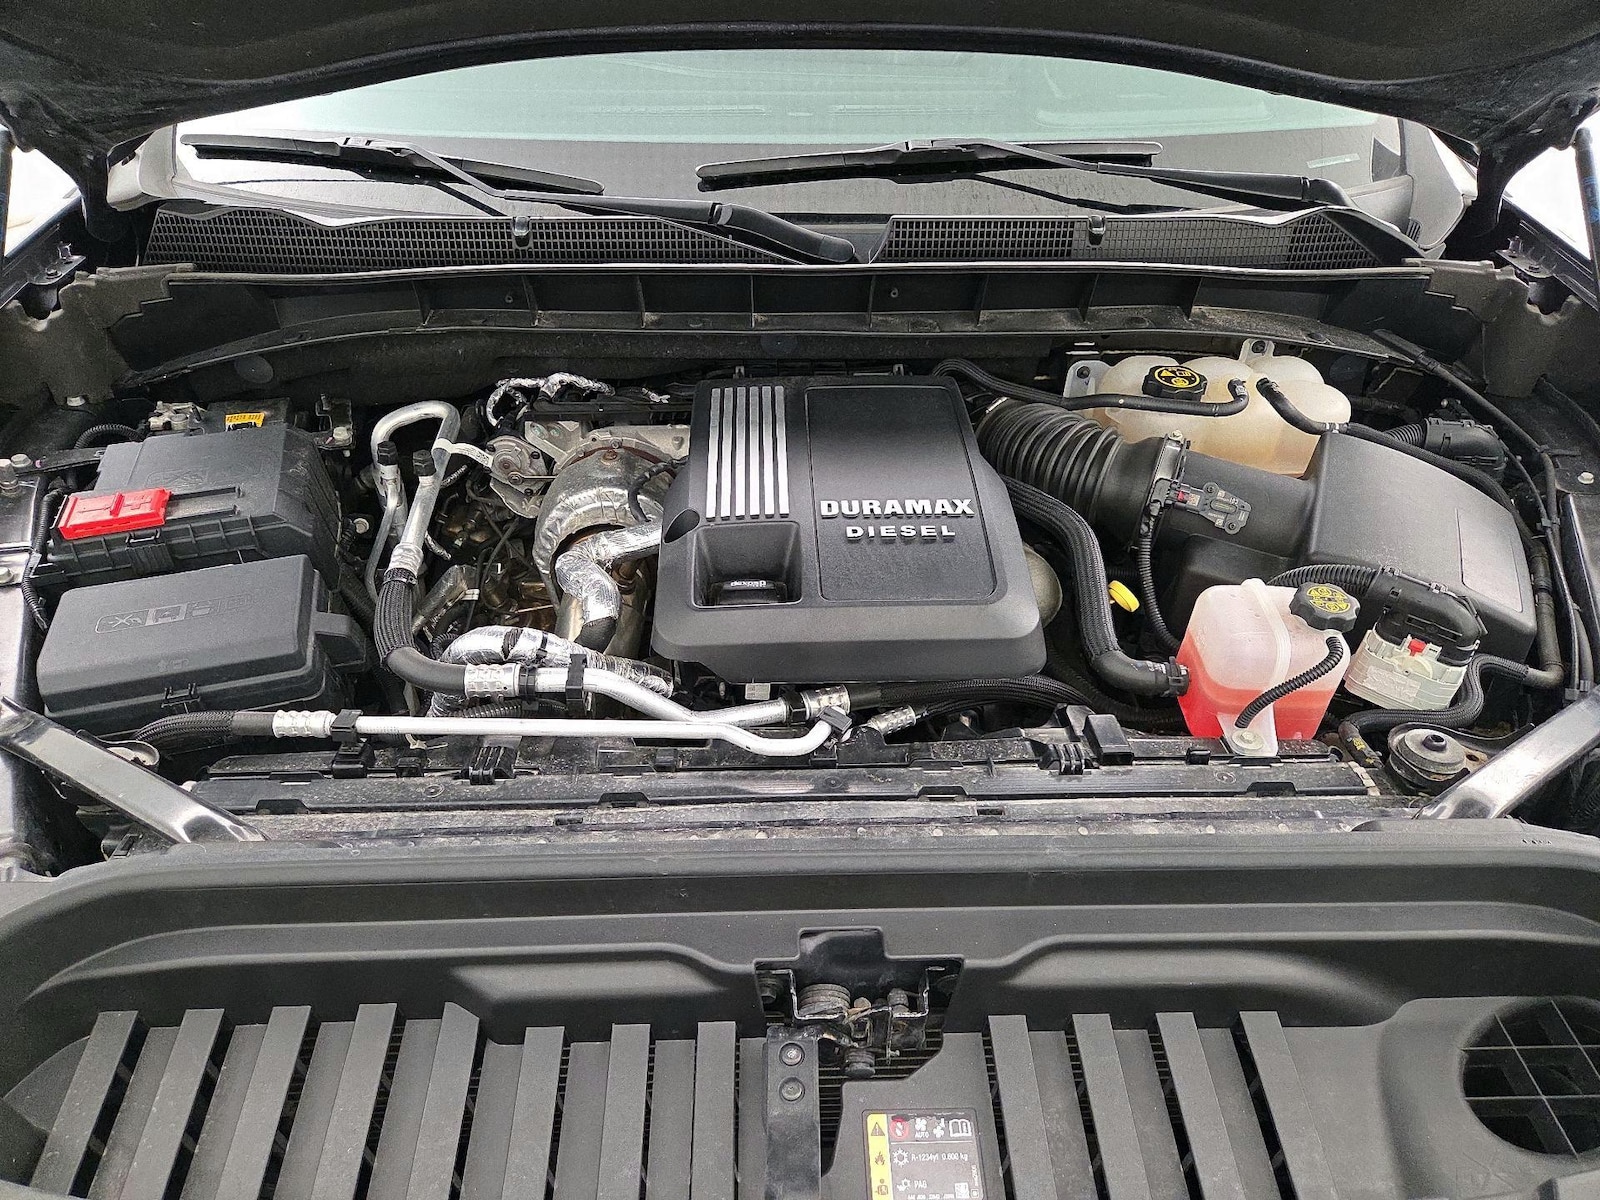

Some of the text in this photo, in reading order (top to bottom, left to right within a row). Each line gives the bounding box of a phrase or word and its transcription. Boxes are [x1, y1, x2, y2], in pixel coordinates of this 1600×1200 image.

[820, 499, 975, 518] DURAMAX
[845, 525, 956, 539] DIESEL
[914, 1131, 930, 1139] AUTO
[960, 1152, 969, 1162] kg
